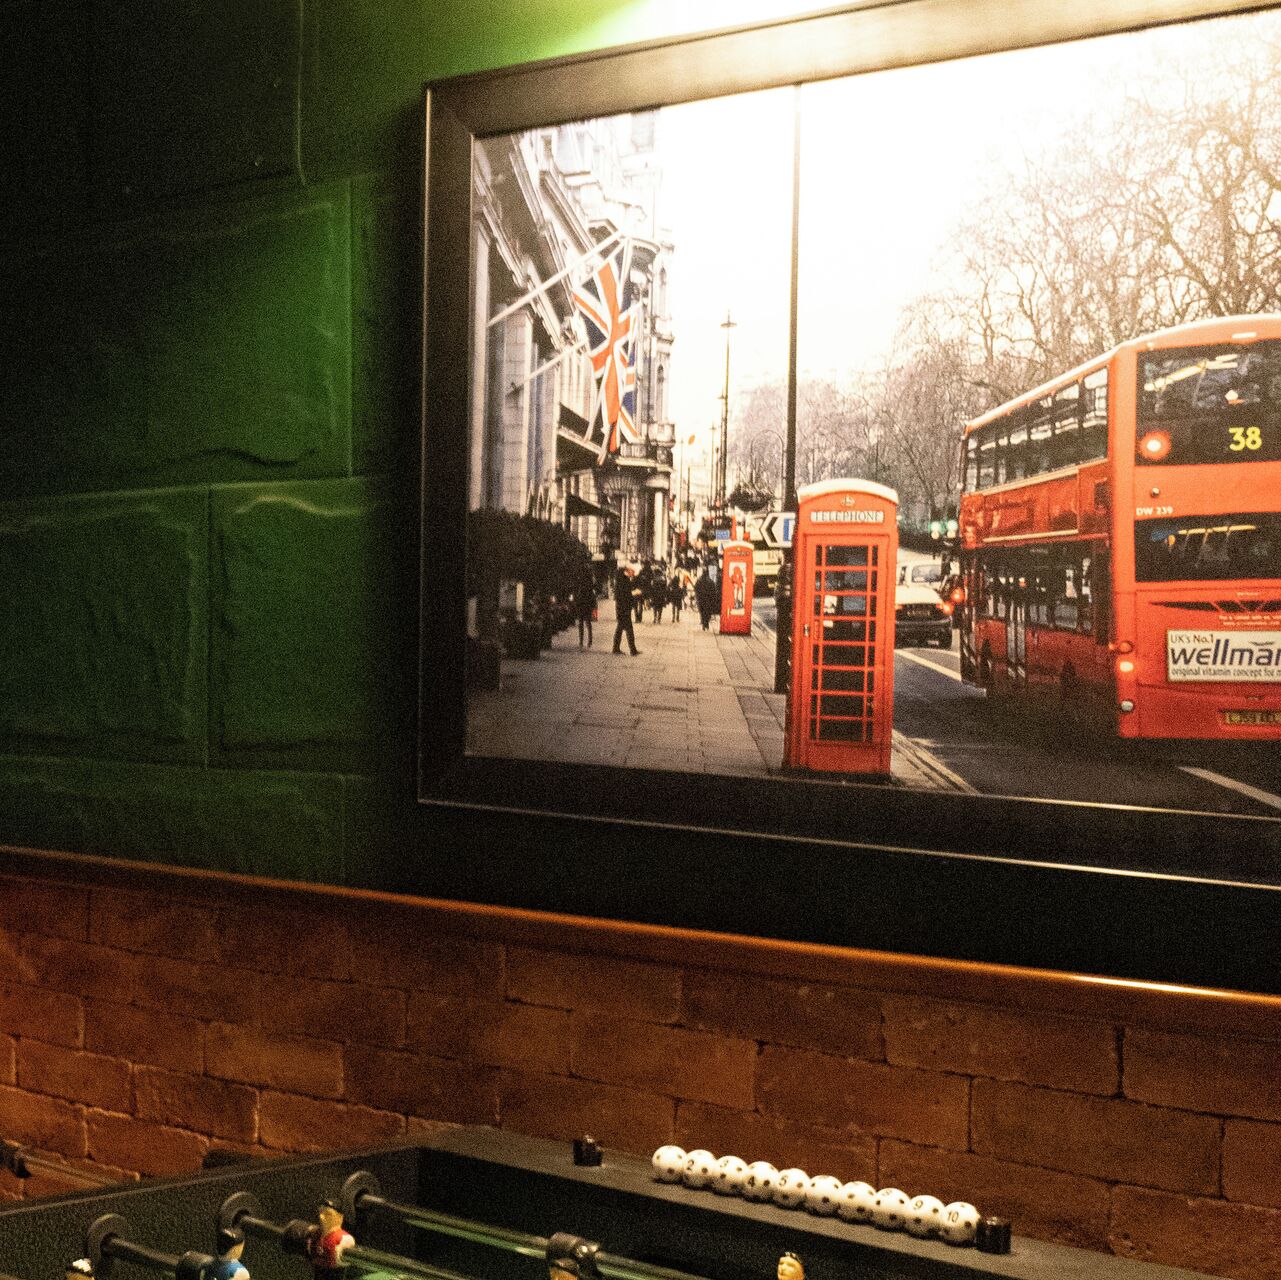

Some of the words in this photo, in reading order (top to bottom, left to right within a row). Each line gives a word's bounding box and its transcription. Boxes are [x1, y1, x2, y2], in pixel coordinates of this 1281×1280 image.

[1228, 426, 1262, 451] 38
[1136, 507, 1153, 516] DW
[1156, 506, 1173, 515] 239
[814, 511, 882, 522] TELEPHONE
[1170, 634, 1190, 643] UK's
[1172, 668, 1200, 677] original
[1202, 668, 1231, 676] vitamin
[1233, 668, 1262, 677] concept
[1264, 668, 1275, 676] for
[948, 1211, 959, 1223] 10
